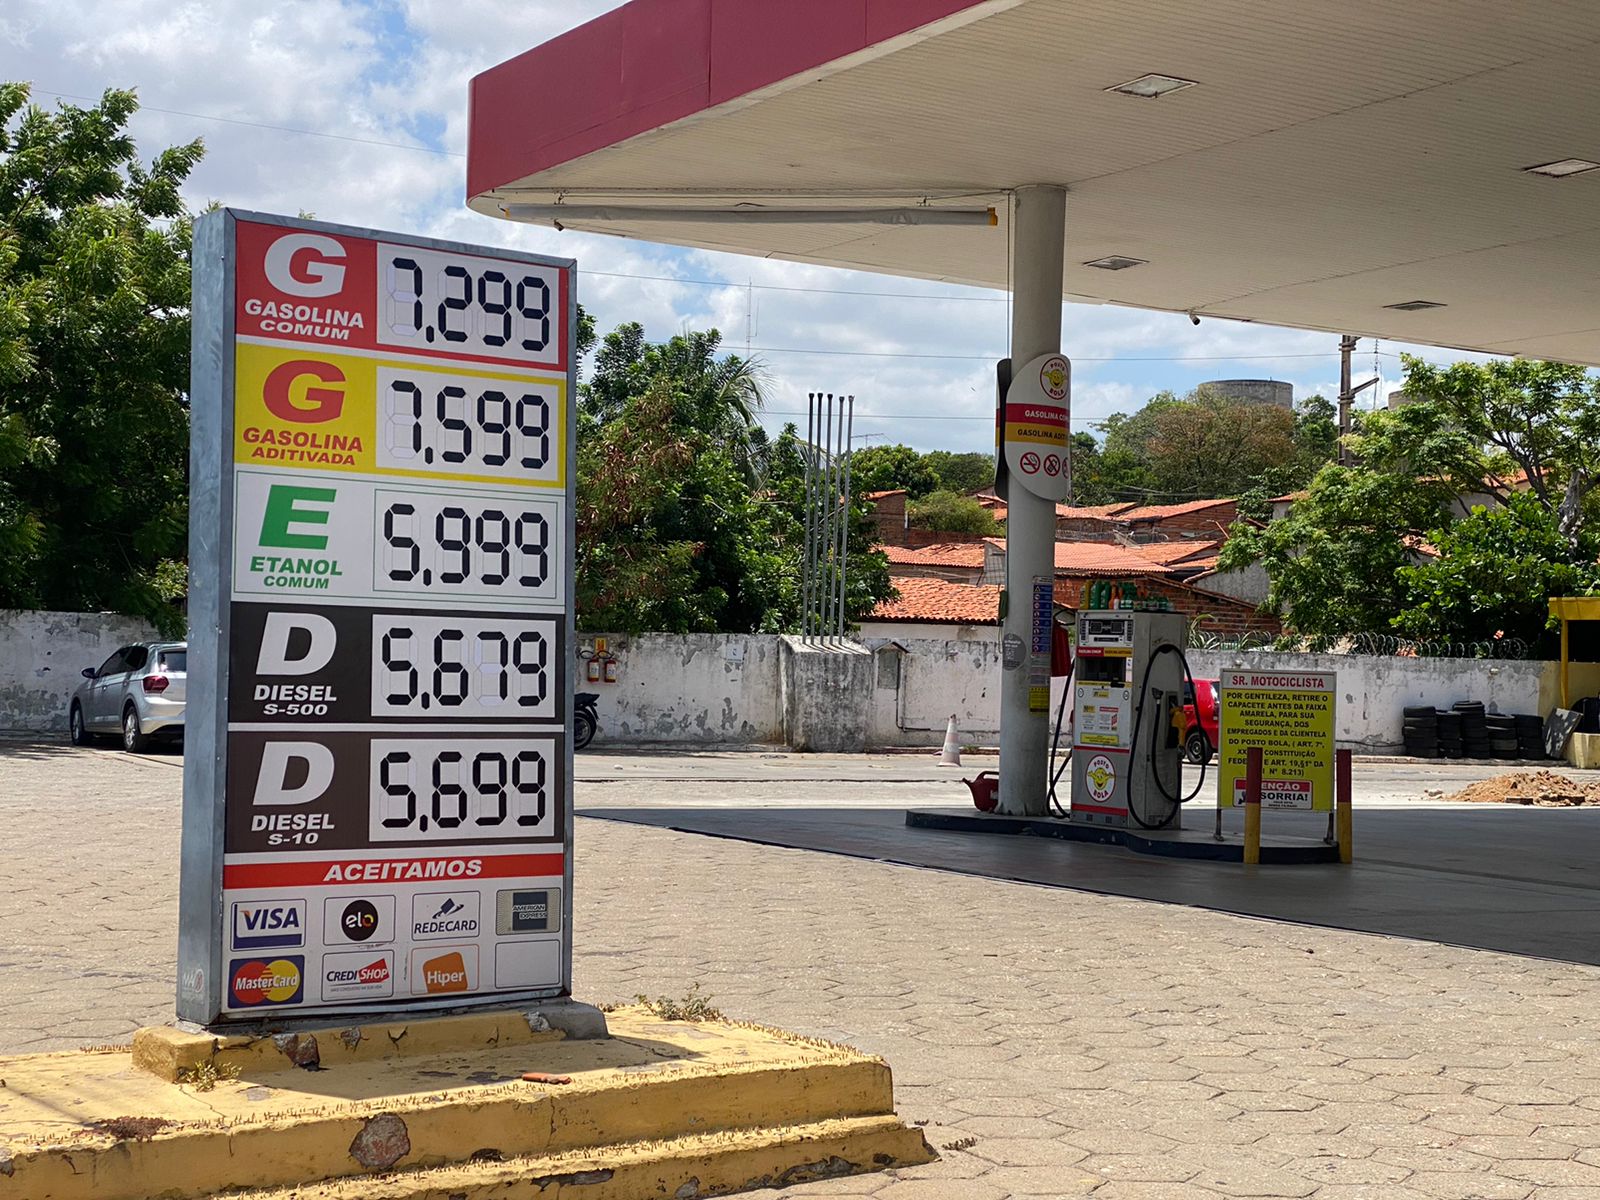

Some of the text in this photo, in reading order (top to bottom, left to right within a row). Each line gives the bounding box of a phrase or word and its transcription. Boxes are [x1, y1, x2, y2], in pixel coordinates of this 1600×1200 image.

[264, 233, 348, 298] G
[245, 299, 364, 329] GASOLINA
[259, 319, 350, 341] COMUM
[262, 359, 346, 424] G
[1024, 409, 1059, 420] GASOLINA
[243, 427, 363, 453] GASOLINA
[1017, 429, 1053, 439] GASOLINA
[251, 446, 356, 466] ADITIVADA
[258, 484, 337, 550] E
[250, 556, 343, 576] ETANOL
[263, 575, 330, 590] COMUM
[255, 611, 337, 676] D
[1232, 675, 1325, 689] SR. MOTOCICLISTA
[253, 684, 337, 702] DIESEL
[1226, 692, 1243, 700] POR
[1244, 693, 1290, 702] GENTILEZA,
[1292, 694, 1319, 702] RETIRE
[263, 703, 328, 716] S-500
[1227, 701, 1328, 711] CAPACETE ANTES DA FAIXA
[1240, 710, 1277, 719] AMARELA,
[1244, 719, 1292, 728] SEGURANÇA,
[1227, 728, 1272, 736] EMPREGADOS
[1290, 730, 1327, 738] CLIENTELA
[1268, 739, 1291, 747] BOLA,
[1263, 749, 1316, 758] CONSTITUIÇÃO
[252, 741, 335, 806] D
[1261, 781, 1300, 791] ENÇÃO
[1260, 791, 1308, 801] SORRIA!
[251, 814, 335, 832] DIESEL
[267, 832, 319, 846] S-10
[323, 859, 482, 882] ACEITAMOS
[512, 903, 546, 913] AMERICAN
[519, 911, 547, 920] EXPRESS
[239, 907, 299, 930] VISA
[345, 911, 374, 928] elo
[413, 920, 477, 934] REDECARD
[235, 973, 298, 991] MasterCard
[427, 971, 464, 986] Hiper
